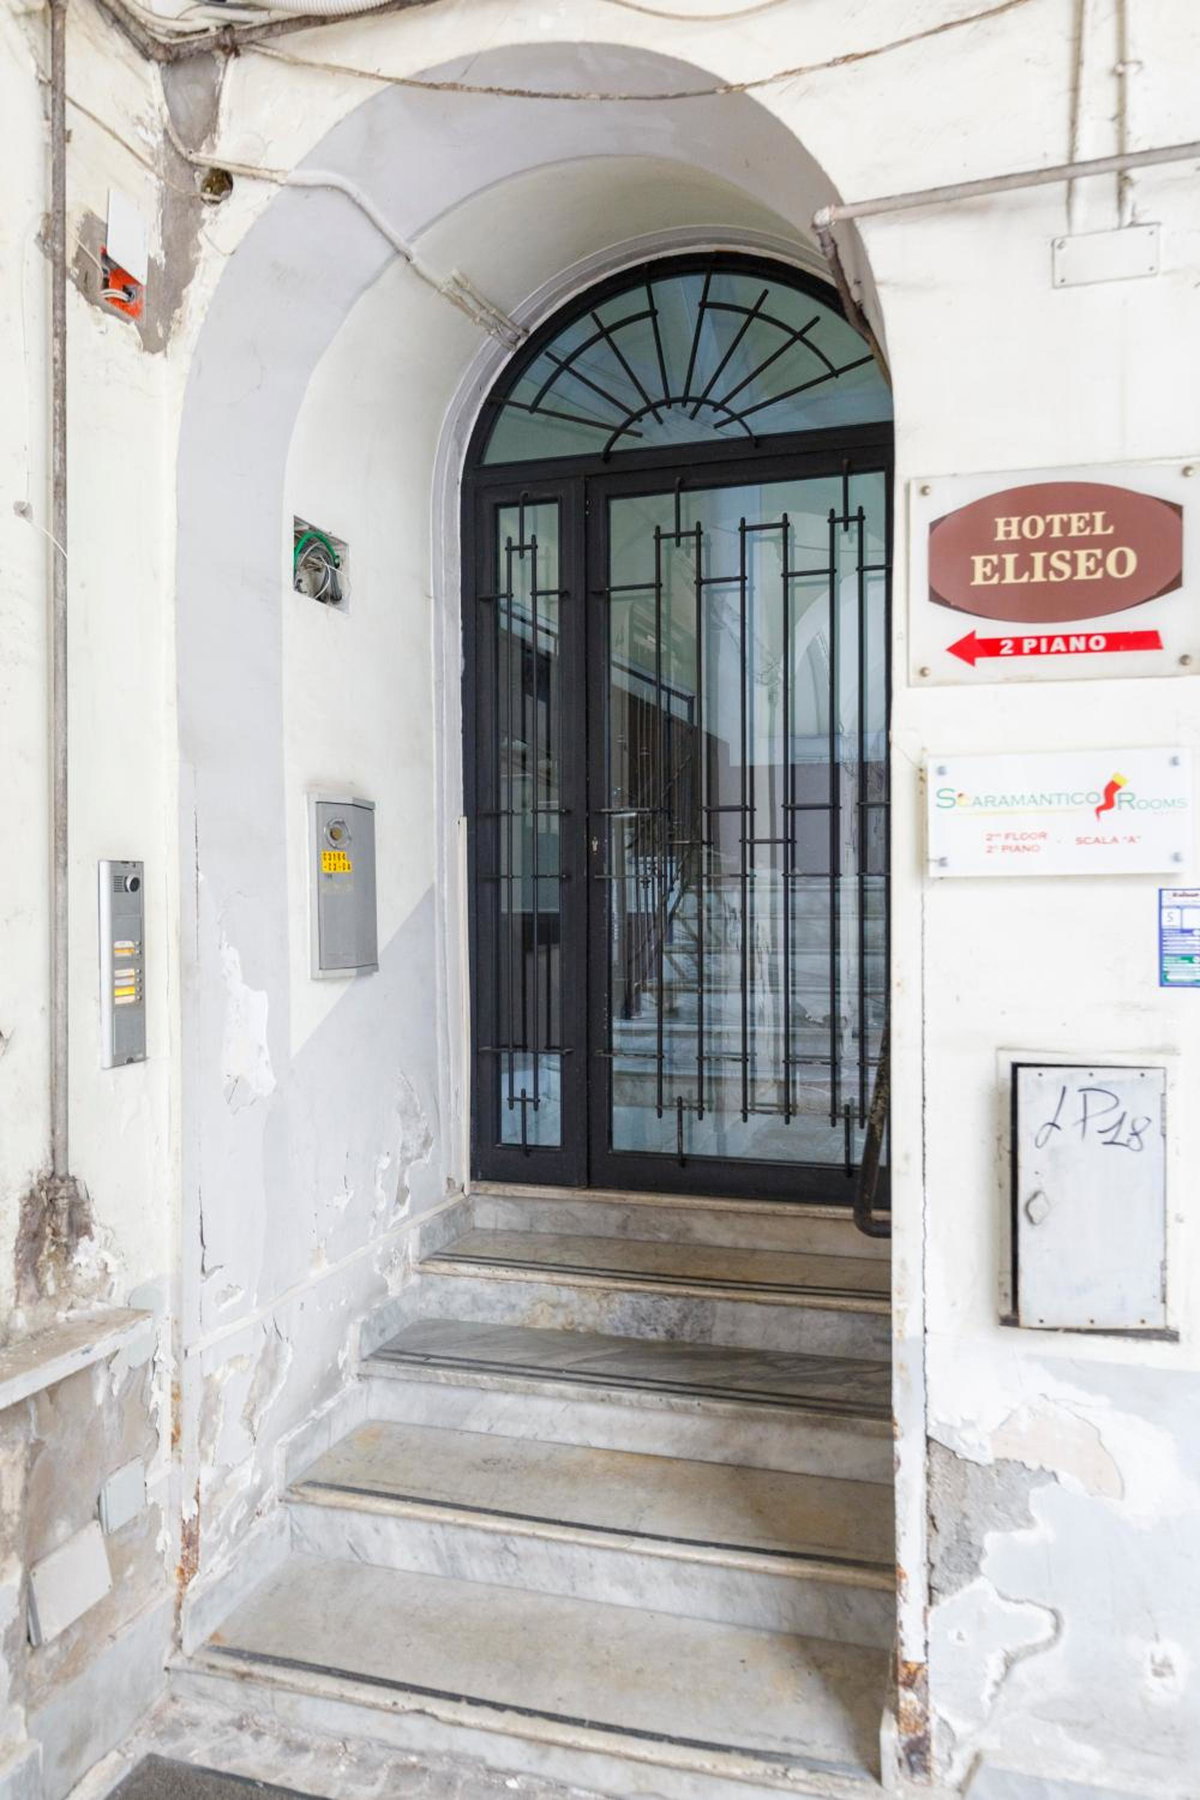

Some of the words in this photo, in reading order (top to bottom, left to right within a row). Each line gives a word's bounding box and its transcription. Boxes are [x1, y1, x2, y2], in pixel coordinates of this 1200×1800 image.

[994, 511, 1114, 541] HOTEL
[970, 547, 1138, 586] ELISEO
[1000, 639, 1013, 654] 2
[1023, 635, 1106, 653] PIANO
[1004, 831, 1047, 841] FLOOR
[1075, 836, 1119, 845] SCALA
[1001, 844, 1041, 853] PIANO
